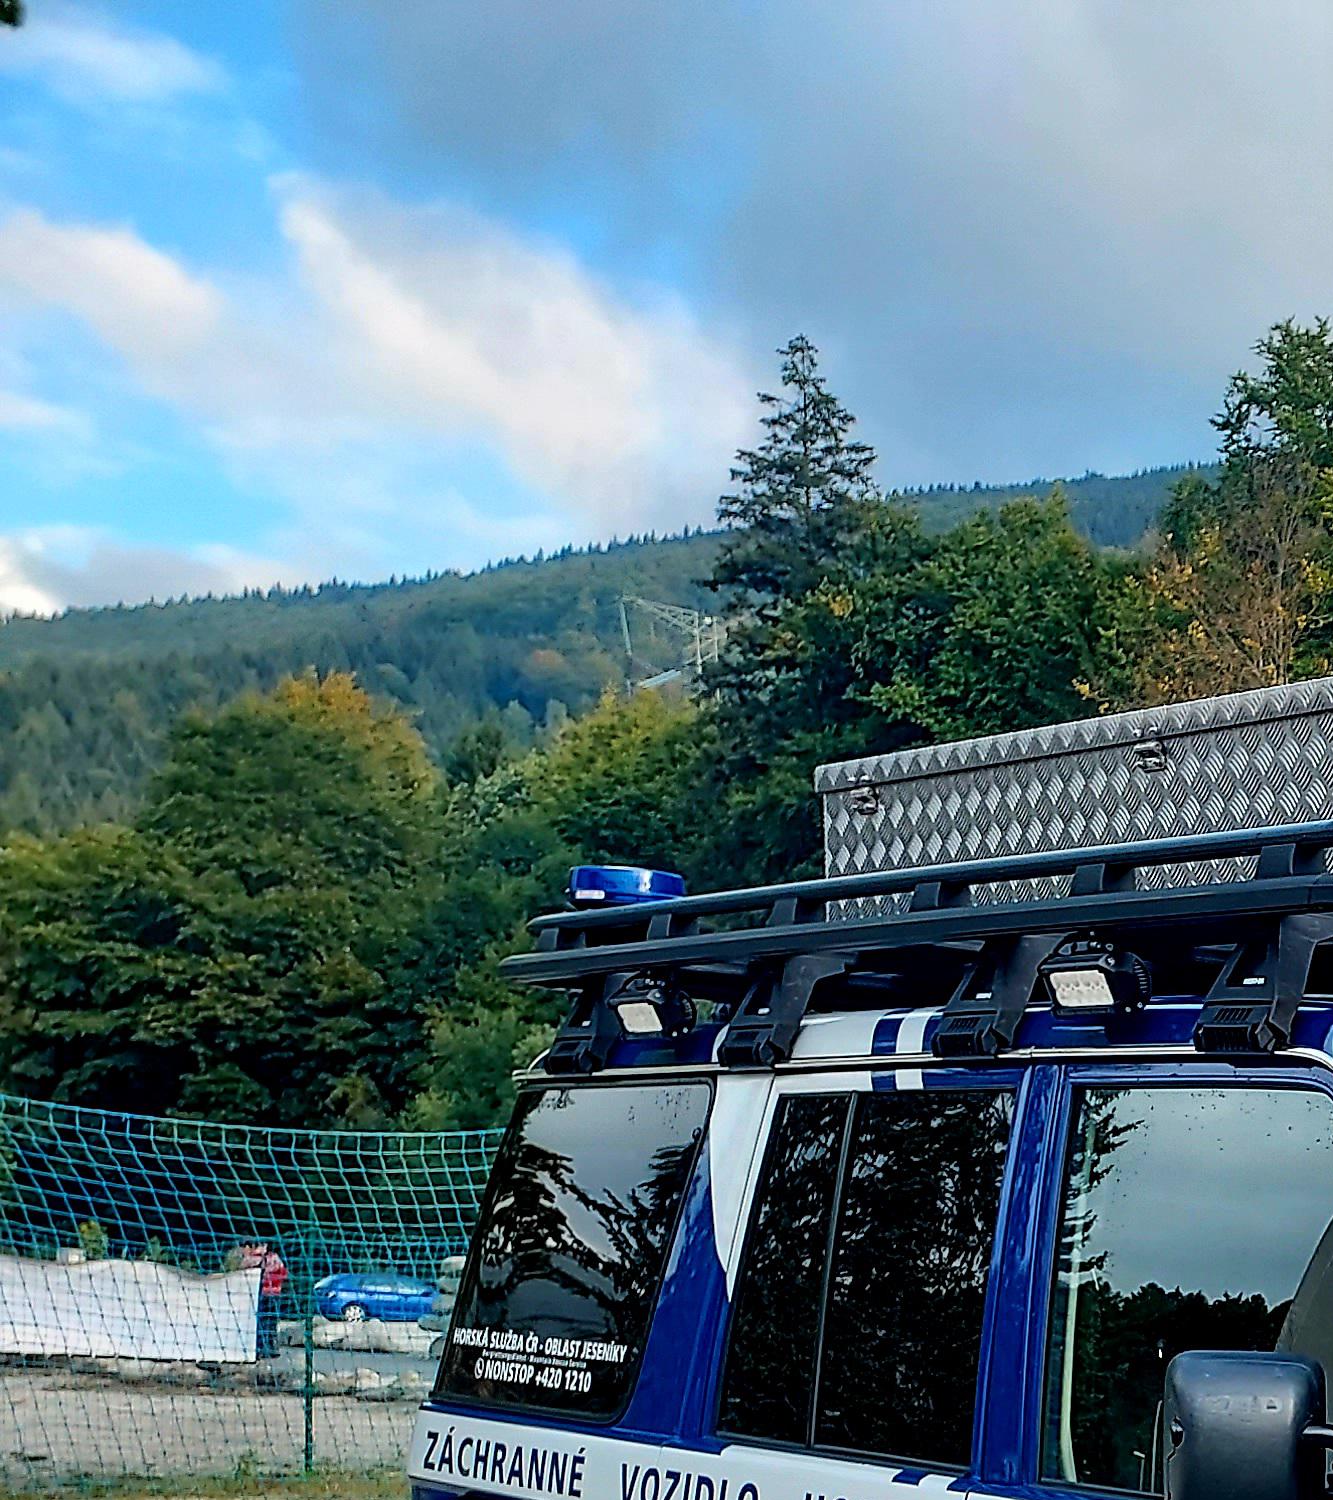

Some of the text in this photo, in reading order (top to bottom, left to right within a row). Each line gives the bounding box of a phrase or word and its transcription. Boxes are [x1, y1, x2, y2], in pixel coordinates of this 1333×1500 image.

[453, 1327, 489, 1347] HORSKÁ
[490, 1329, 524, 1352] SLUŽBA
[526, 1331, 539, 1353] ČR
[545, 1337, 580, 1358] OBLAST
[580, 1340, 628, 1363] JESENÍKY
[484, 1359, 534, 1385] NONSTOP
[535, 1367, 562, 1389] +420
[565, 1370, 592, 1393] 1210
[423, 1426, 587, 1499] ZÁCHRANNÉ
